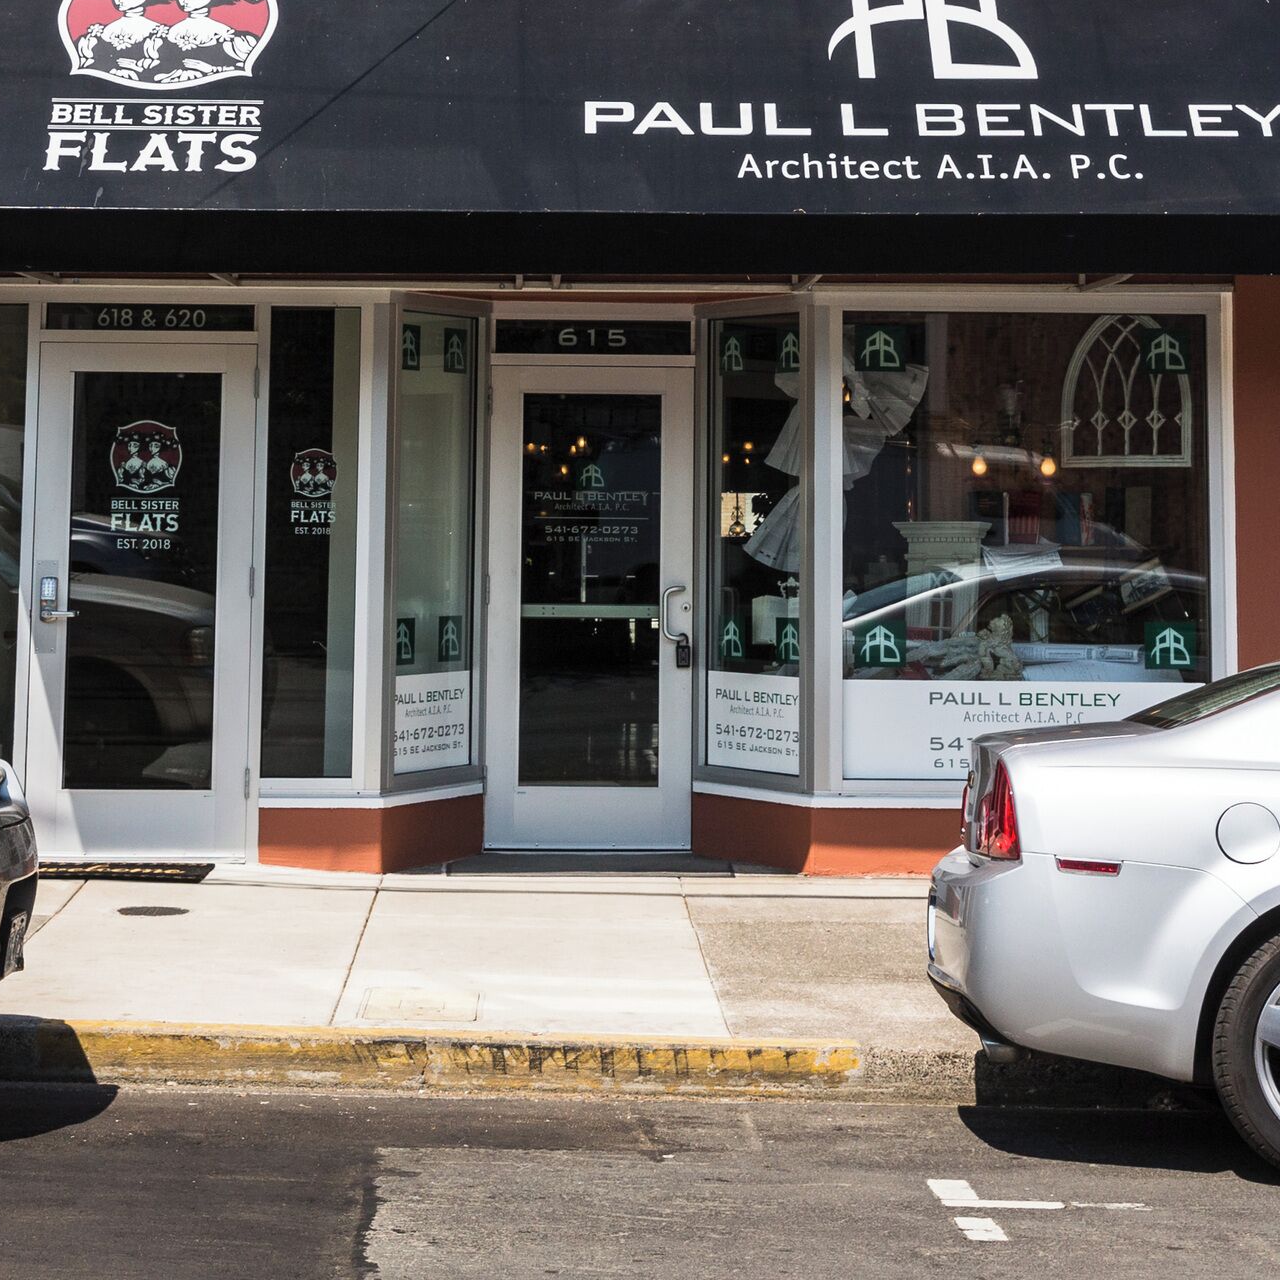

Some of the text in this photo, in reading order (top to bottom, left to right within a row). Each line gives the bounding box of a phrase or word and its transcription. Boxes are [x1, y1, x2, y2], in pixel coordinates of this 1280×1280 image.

[50, 104, 261, 126] BELL SISTER
[584, 101, 811, 136] PAUL
[840, 103, 889, 136] L
[42, 130, 259, 173] FLATS
[737, 153, 1144, 180] Architect A.I.A. P.C.
[98, 308, 206, 328] 618 & 620
[558, 327, 627, 347] 615
[534, 491, 572, 501] PAUL
[587, 491, 649, 503] BENTLEY
[111, 500, 179, 510] BELL SISTER
[291, 501, 337, 509] BELL SISTER
[111, 513, 179, 532] FLATS
[290, 510, 336, 523] FLATS
[294, 526, 332, 536] EST. 2018
[544, 525, 639, 534] 541-672-0273
[116, 538, 171, 550] EST. 2018
[394, 688, 465, 704] PAUL L BENTLEY
[715, 688, 799, 706] PAUL L BENTLEY
[928, 692, 1121, 707] PAUL L BENTLEY
[963, 711, 1021, 724] Architect
[1024, 711, 1061, 724] A.I.A.
[715, 723, 799, 743] 541-672-0273
[717, 740, 734, 750] 615
[736, 742, 747, 751] SE
[929, 737, 973, 751] 54
[933, 758, 970, 769] 615
